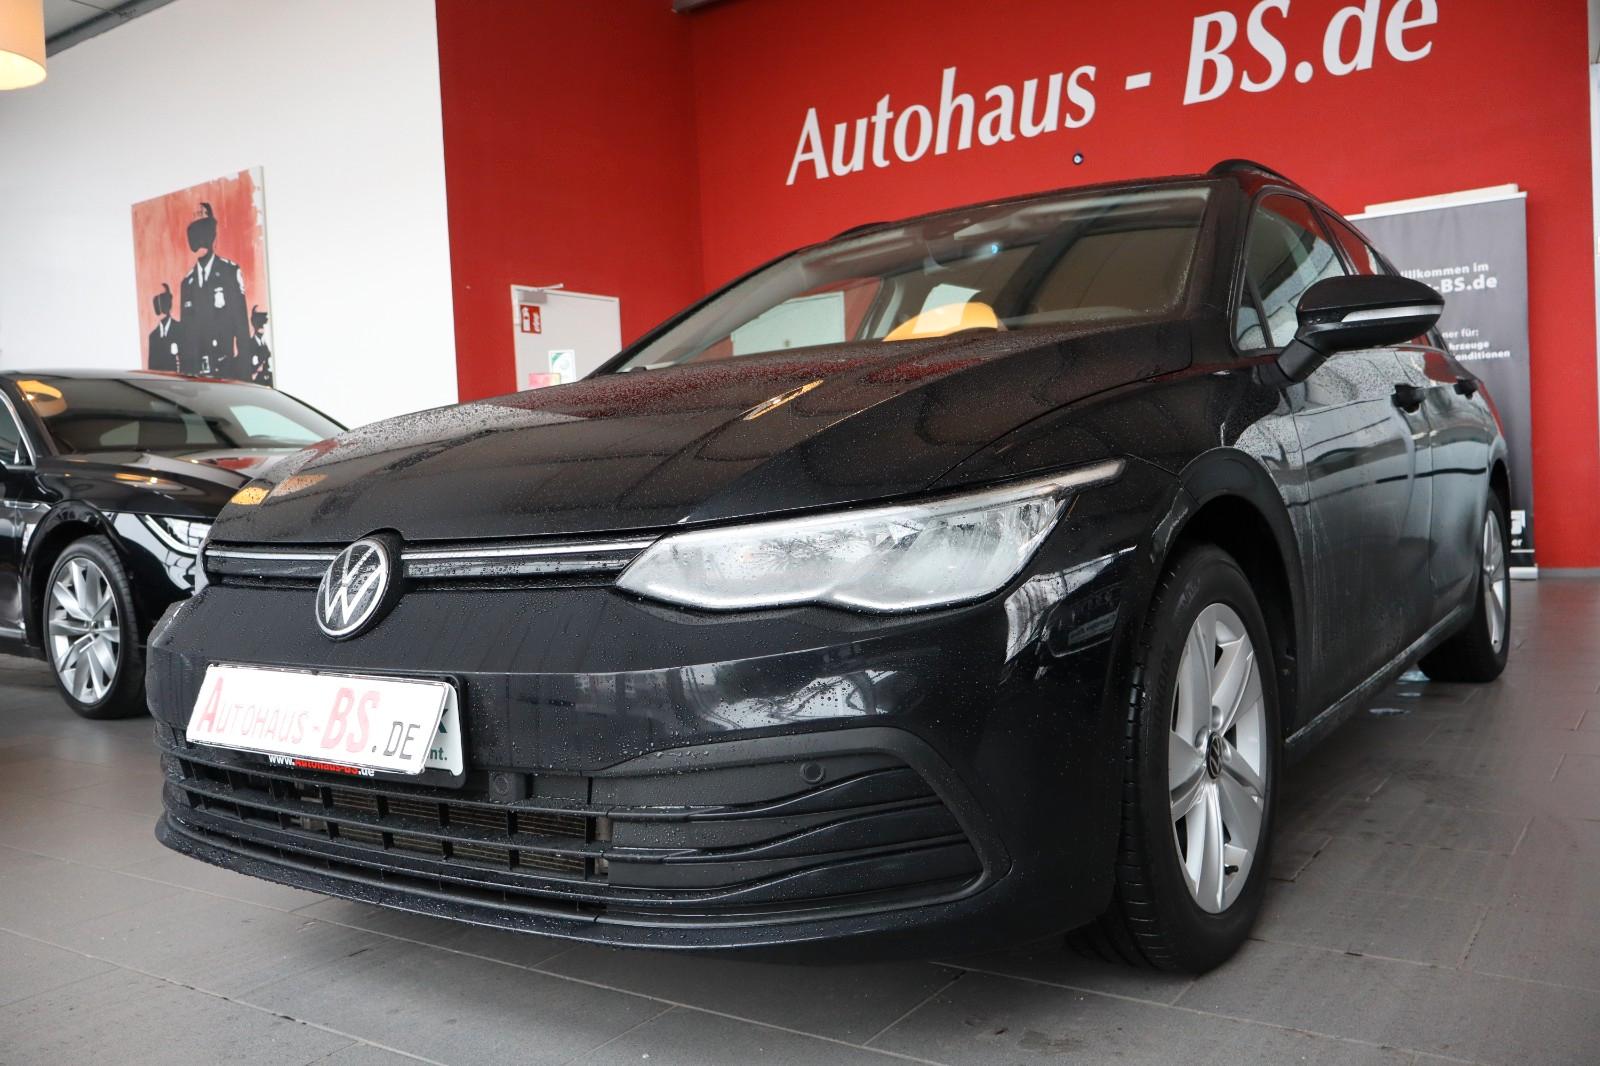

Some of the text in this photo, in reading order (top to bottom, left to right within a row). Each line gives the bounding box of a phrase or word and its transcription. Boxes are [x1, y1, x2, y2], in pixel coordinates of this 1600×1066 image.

[786, 65, 1097, 186] Autohaus
[1183, 0, 1439, 106] BS.de
[1401, 262, 1489, 279] illkommen im
[1427, 274, 1498, 294] -BS.de
[1454, 350, 1511, 361] onditionen
